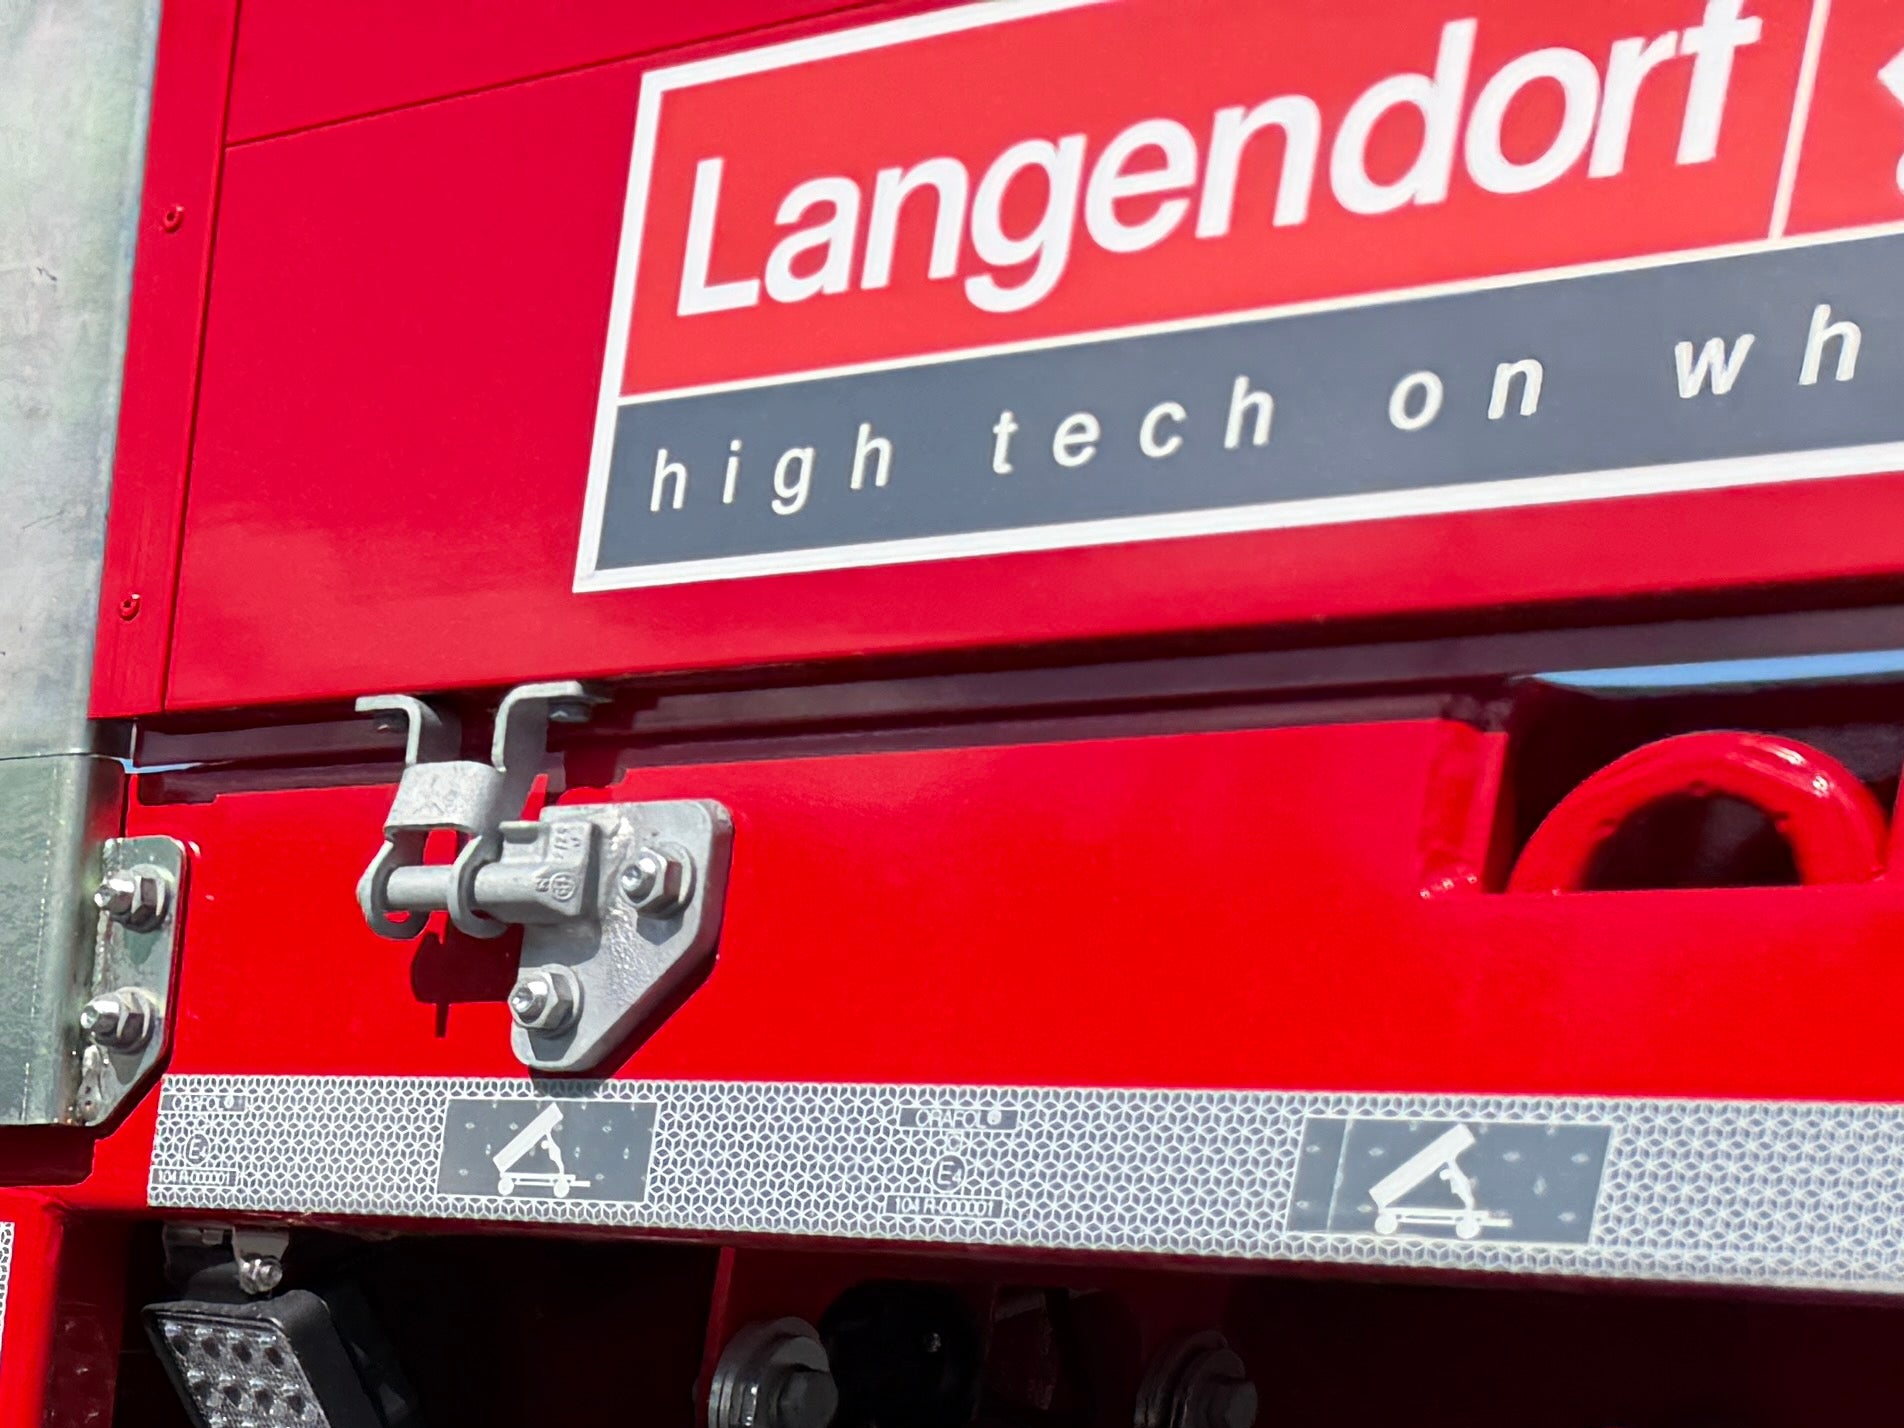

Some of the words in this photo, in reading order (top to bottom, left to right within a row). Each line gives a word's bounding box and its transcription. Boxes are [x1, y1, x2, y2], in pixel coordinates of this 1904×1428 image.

[676, 0, 1763, 316] Langendorf
[651, 423, 891, 515] high
[993, 376, 1273, 473] tech
[1389, 359, 1542, 430] on
[1675, 304, 1861, 398] wh
